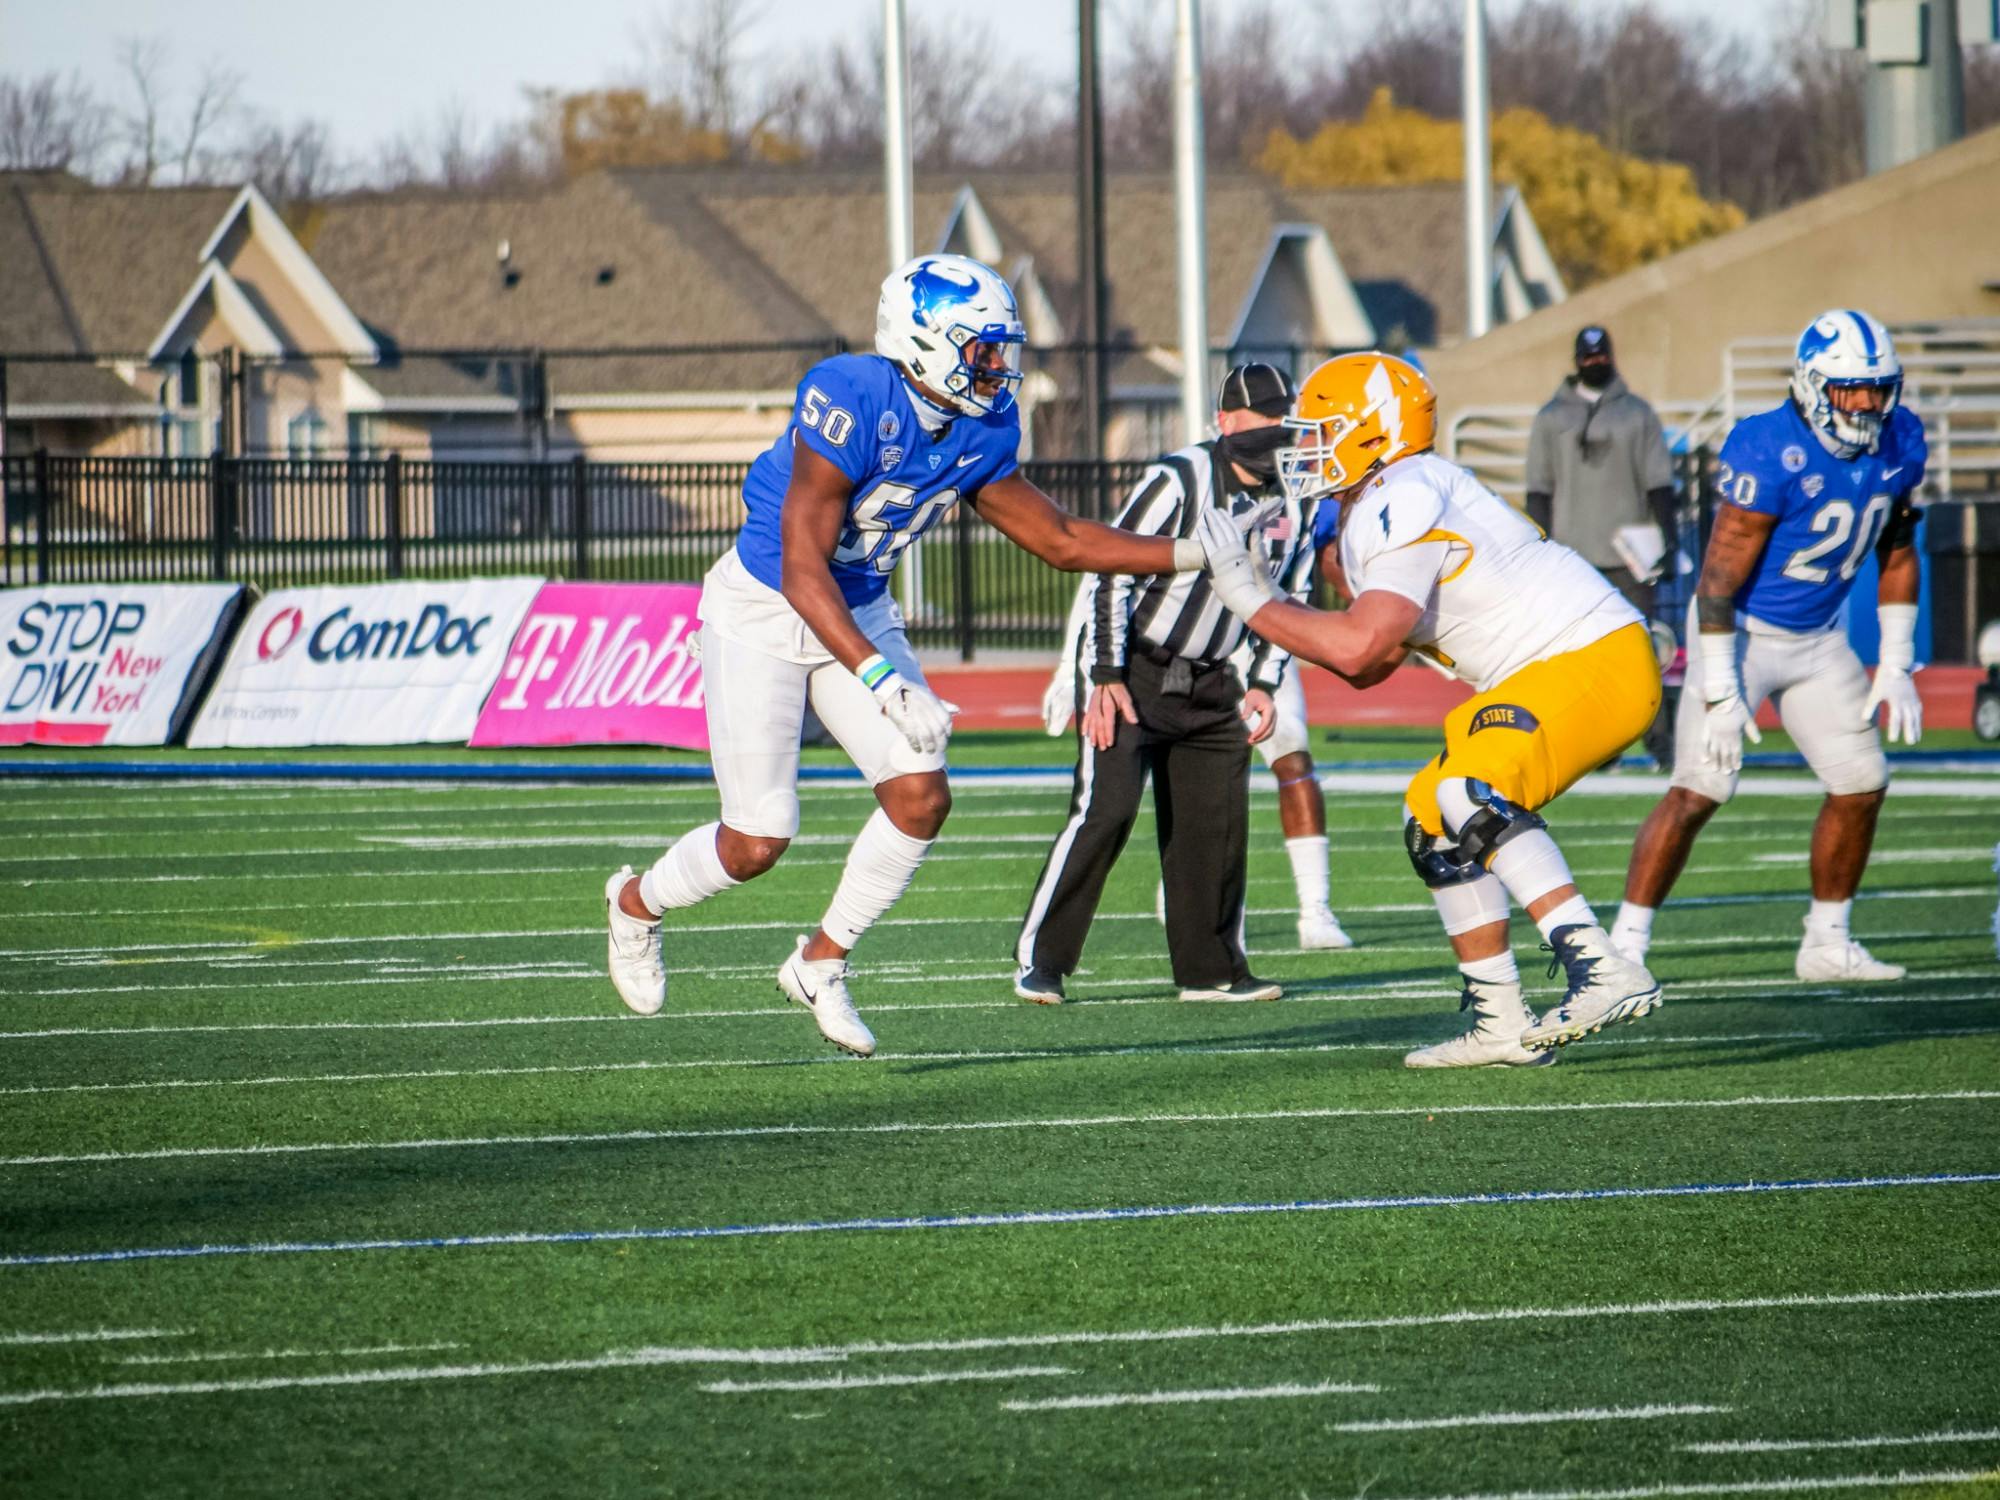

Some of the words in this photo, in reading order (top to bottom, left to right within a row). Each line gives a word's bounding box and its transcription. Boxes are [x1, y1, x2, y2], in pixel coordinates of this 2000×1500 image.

[800, 385, 856, 447] 50
[1717, 463, 1758, 506] 20
[831, 480, 960, 575] 50
[1781, 494, 1892, 585] 20
[7, 599, 147, 658] STOP
[308, 604, 492, 662] ComDoc
[106, 647, 165, 679] New
[1482, 708, 1516, 725] STATE
